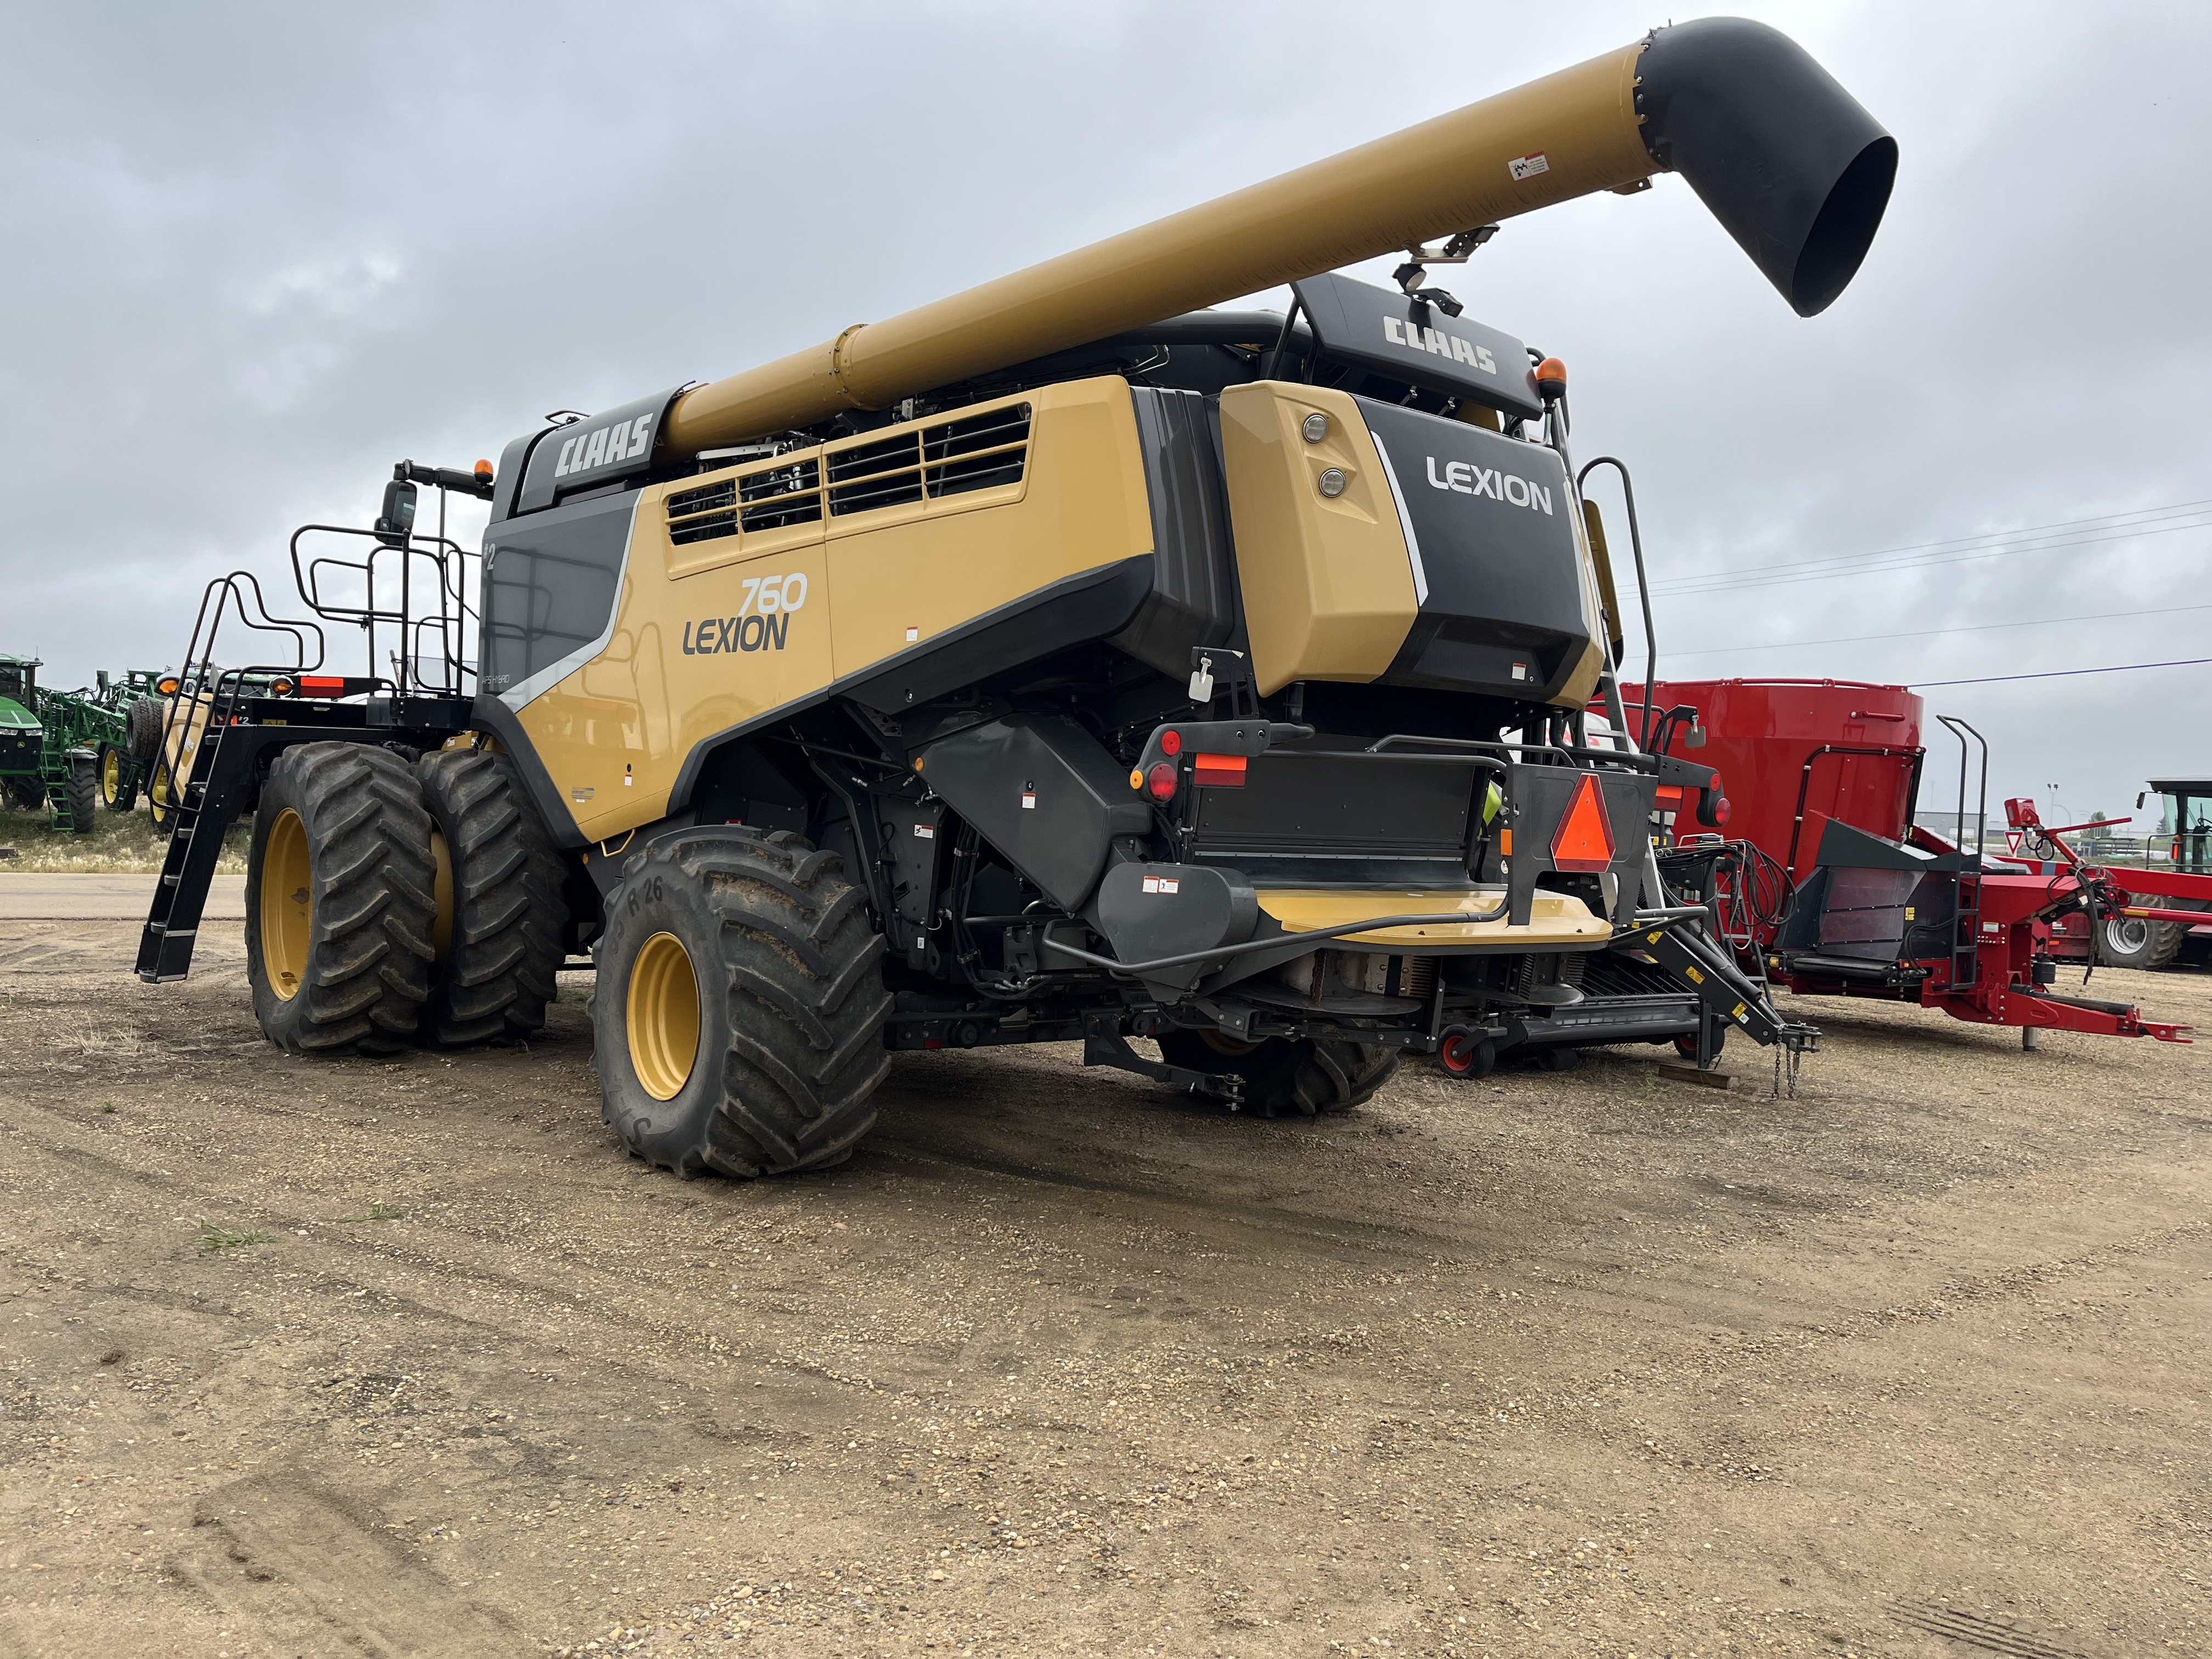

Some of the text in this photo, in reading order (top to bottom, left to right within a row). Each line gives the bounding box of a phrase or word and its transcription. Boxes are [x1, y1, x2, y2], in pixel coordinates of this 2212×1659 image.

[1384, 316, 1497, 375] CLAAS
[555, 413, 653, 477] CLAAS
[1426, 456, 1554, 515] LEXION
[483, 543, 496, 570] #2
[738, 572, 808, 616] 760
[683, 612, 789, 655] LEXION
[627, 888, 640, 917] R
[644, 876, 664, 904] 26
